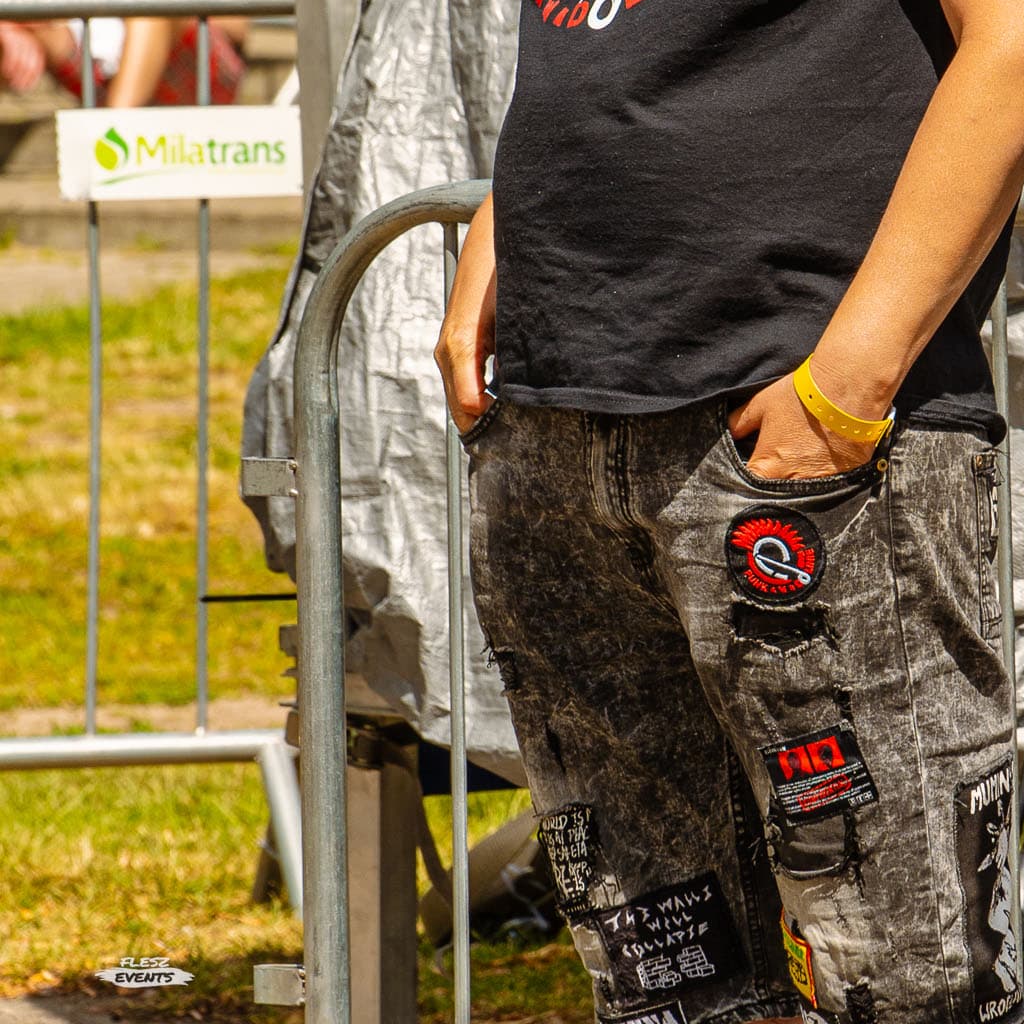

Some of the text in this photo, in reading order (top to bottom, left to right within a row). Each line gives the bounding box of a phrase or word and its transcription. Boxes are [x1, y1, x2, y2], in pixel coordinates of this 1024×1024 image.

[136, 133, 286, 165] Milatrans
[542, 814, 568, 831] ORLD
[656, 885, 712, 914] WALLS
[646, 912, 692, 932] WILL
[622, 922, 709, 958] COLLAPSE
